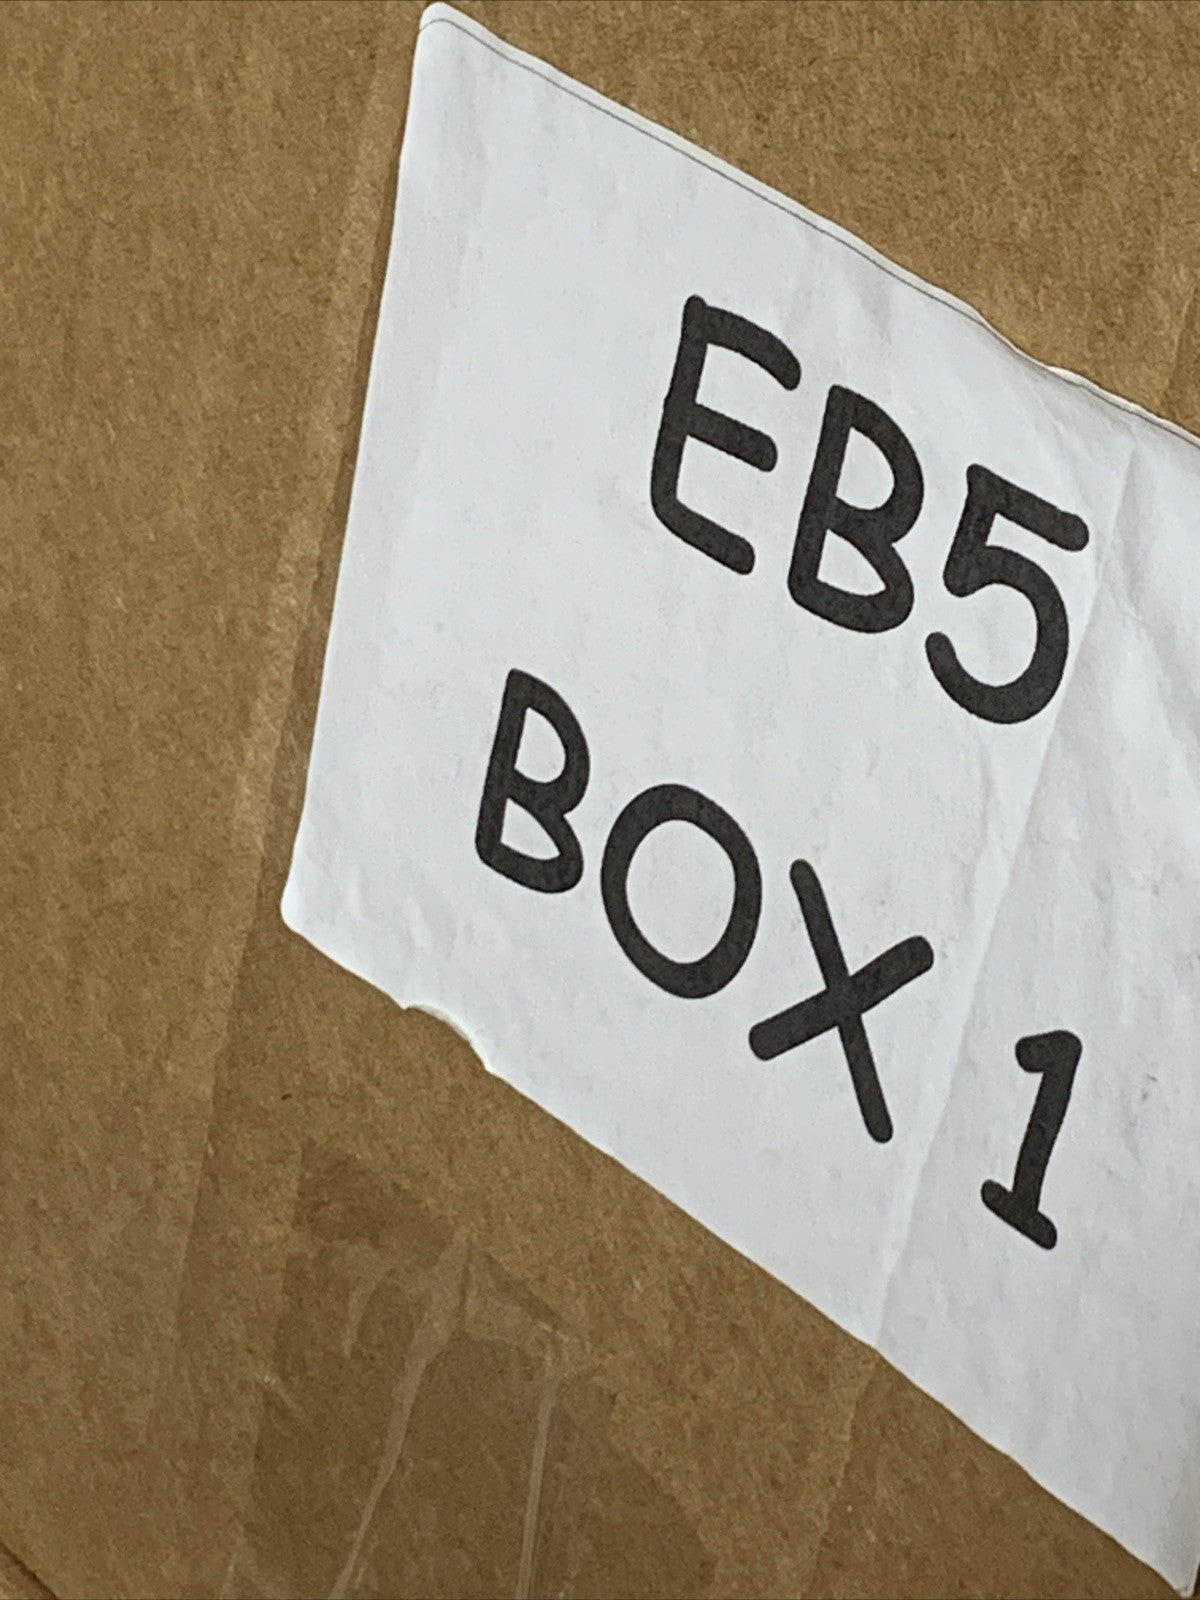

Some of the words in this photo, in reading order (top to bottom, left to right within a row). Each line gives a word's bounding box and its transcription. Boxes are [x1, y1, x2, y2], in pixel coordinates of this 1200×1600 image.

[650, 294, 1090, 725] EB5
[474, 667, 935, 1144] BOX
[979, 1029, 1083, 1251] 1
